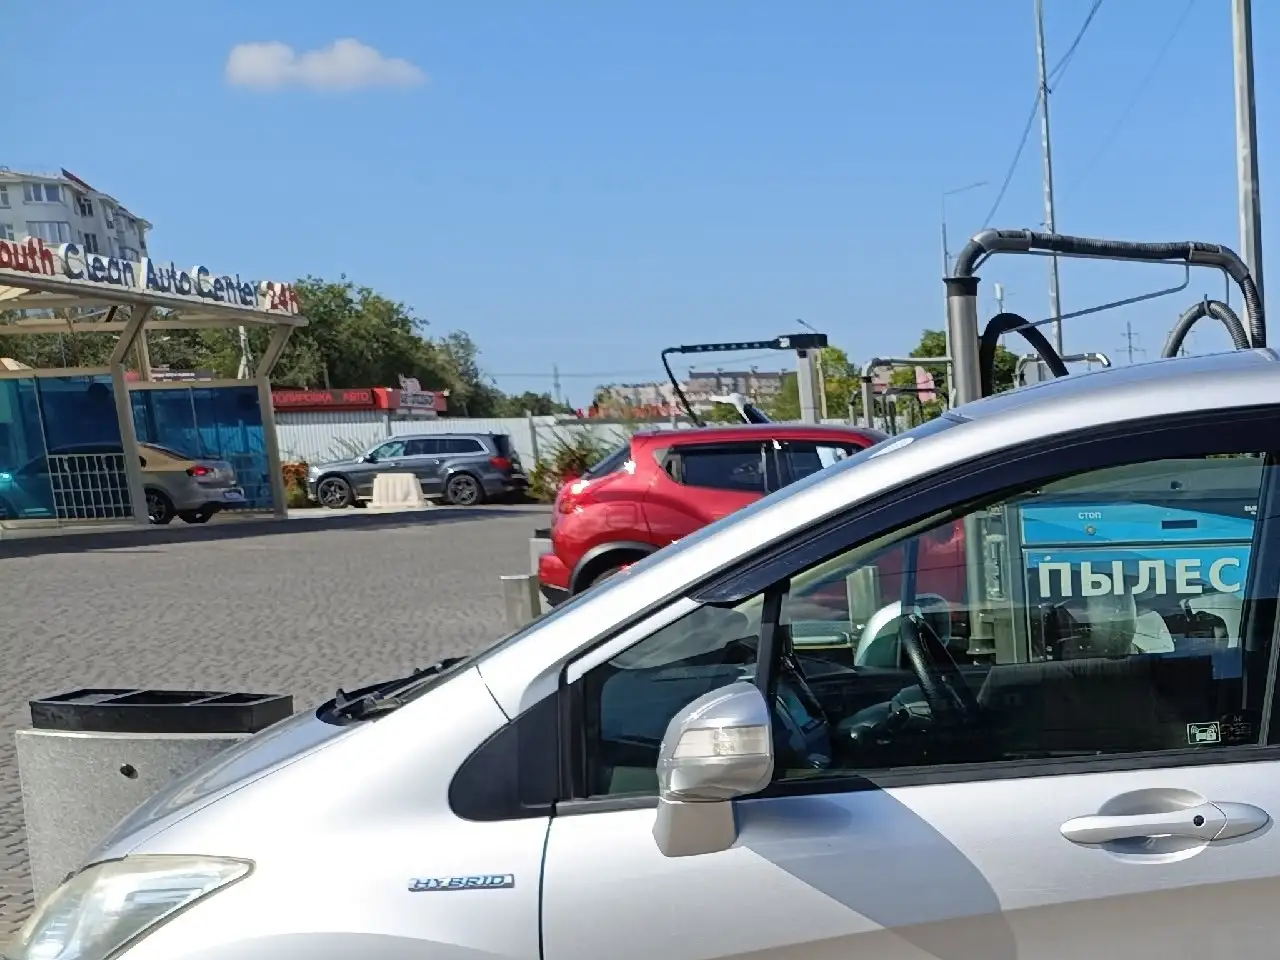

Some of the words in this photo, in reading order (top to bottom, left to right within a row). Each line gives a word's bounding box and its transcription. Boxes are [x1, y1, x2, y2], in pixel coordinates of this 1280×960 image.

[62, 243, 136, 288] Clean
[146, 257, 191, 295] Auto
[197, 265, 259, 306] Center
[343, 390, 370, 402] АВТО
[1038, 556, 1241, 598] ПЫЛЕС
[413, 874, 506, 890] HYBRID
